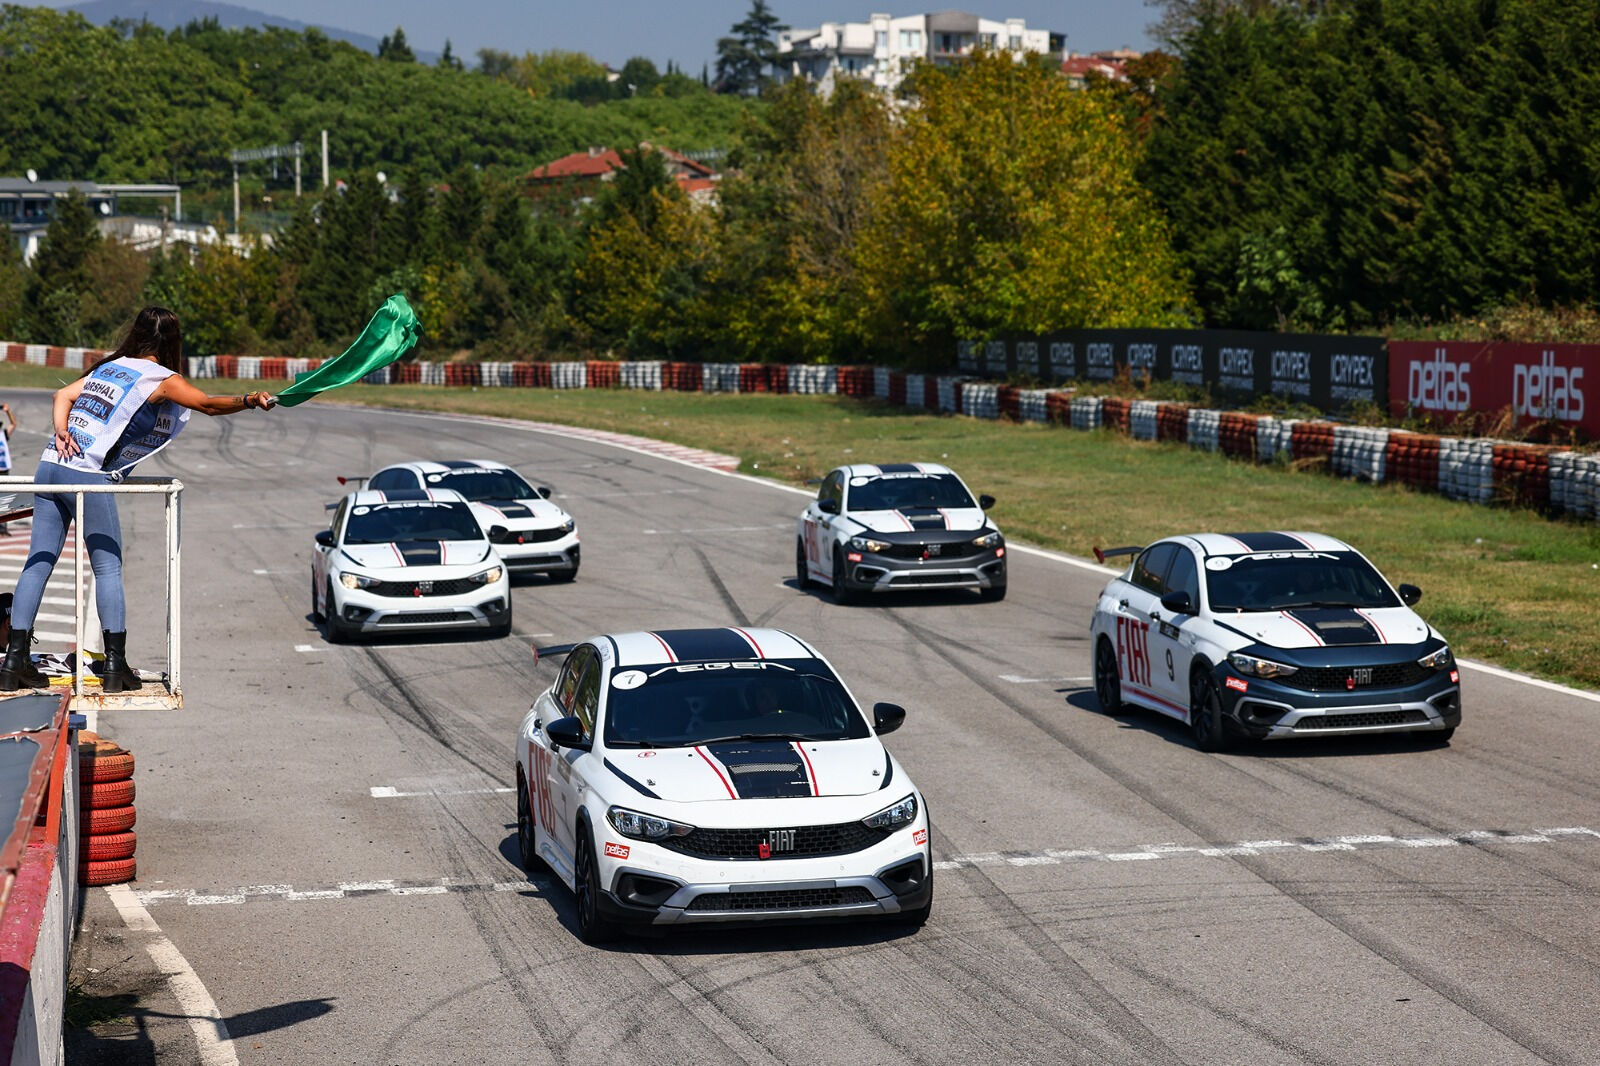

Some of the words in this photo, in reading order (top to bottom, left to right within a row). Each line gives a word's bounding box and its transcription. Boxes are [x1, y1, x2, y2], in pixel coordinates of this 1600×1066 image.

[1330, 354, 1374, 385] ICRYPEX
[1408, 348, 1470, 418] petlas
[1512, 350, 1584, 426] petlas
[1117, 616, 1151, 687] FIAT
[1166, 648, 1174, 682] 9
[624, 674, 636, 685] 7
[1353, 668, 1373, 684] FIAT
[605, 844, 629, 857] petlas
[769, 830, 796, 851] FIAT
